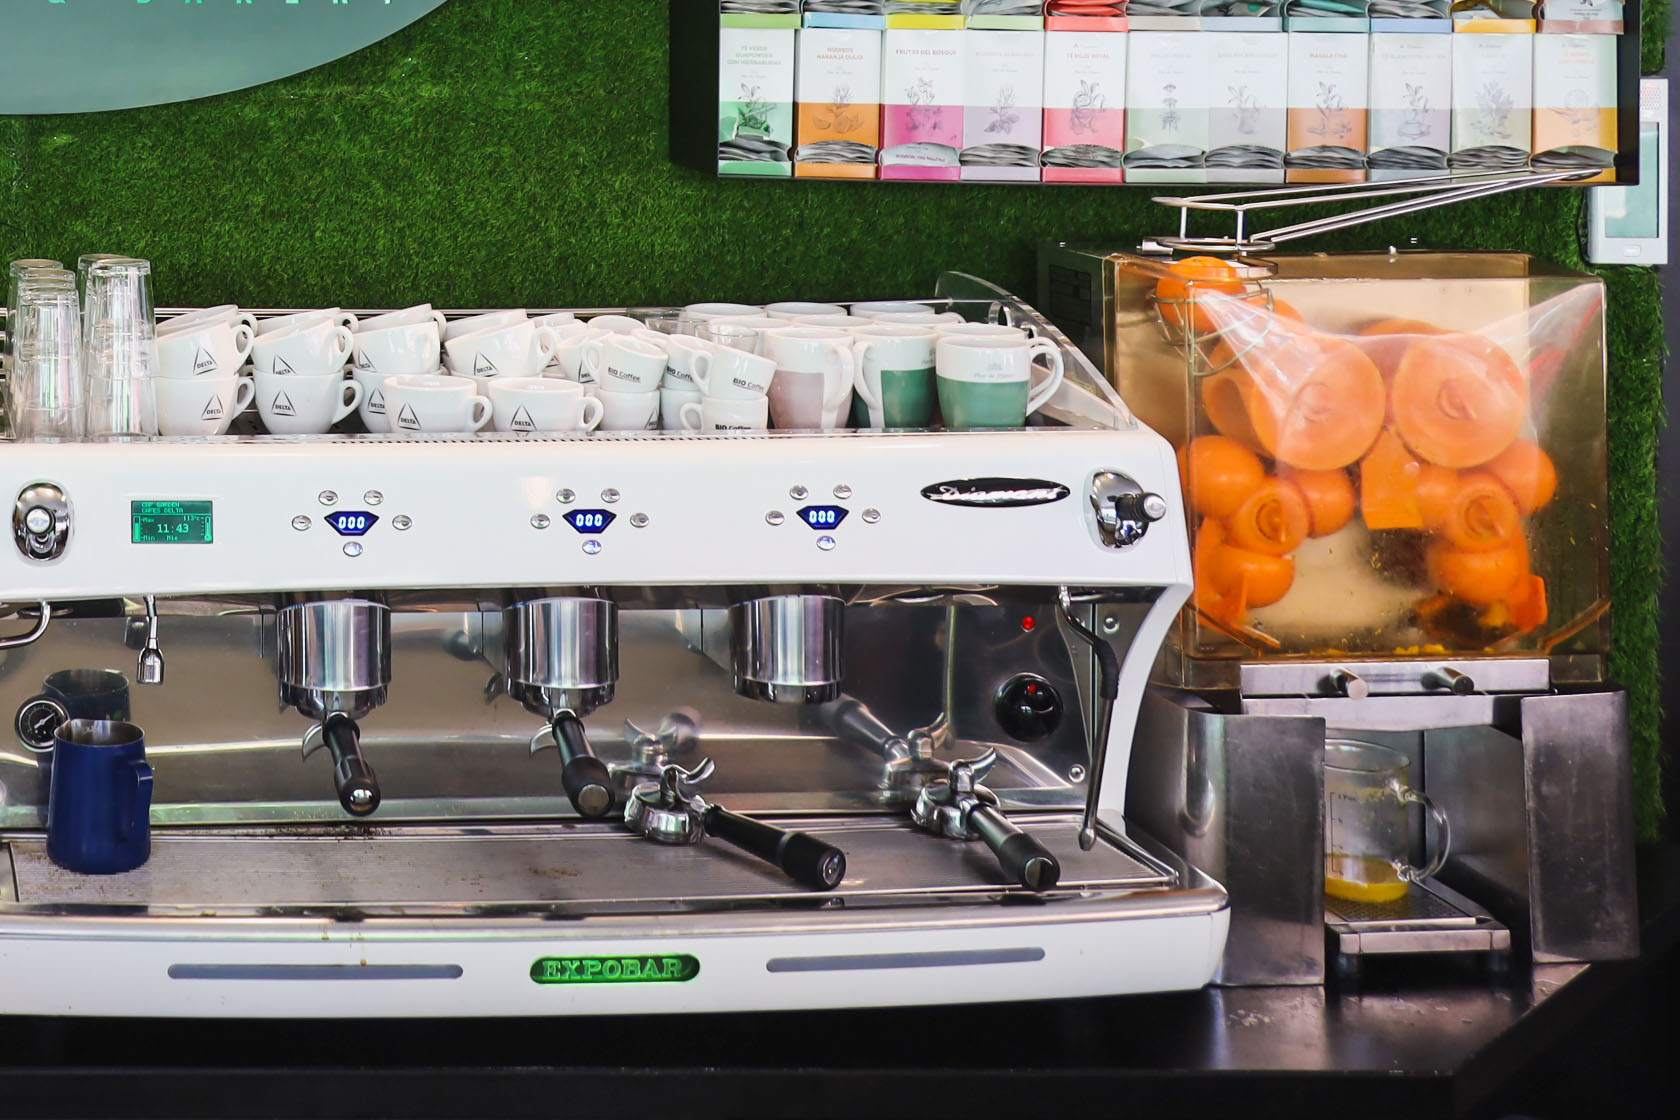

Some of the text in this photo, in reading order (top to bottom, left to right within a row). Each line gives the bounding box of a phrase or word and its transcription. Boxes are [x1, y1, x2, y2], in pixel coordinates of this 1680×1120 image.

[196, 359, 214, 370] DELTA
[475, 365, 493, 374] DELTA
[666, 365, 676, 374] BIO
[608, 366, 641, 382] BIO Coffee
[733, 377, 747, 386] BIO
[274, 404, 292, 412] DELTA
[369, 401, 385, 410] DELTA
[399, 416, 417, 426] DELTA
[513, 419, 532, 428] DELTA
[575, 513, 603, 527] 000
[809, 510, 835, 523] 000
[338, 515, 366, 529] 000
[156, 523, 190, 534] 11:43
[542, 957, 683, 980] EXPOBAR
